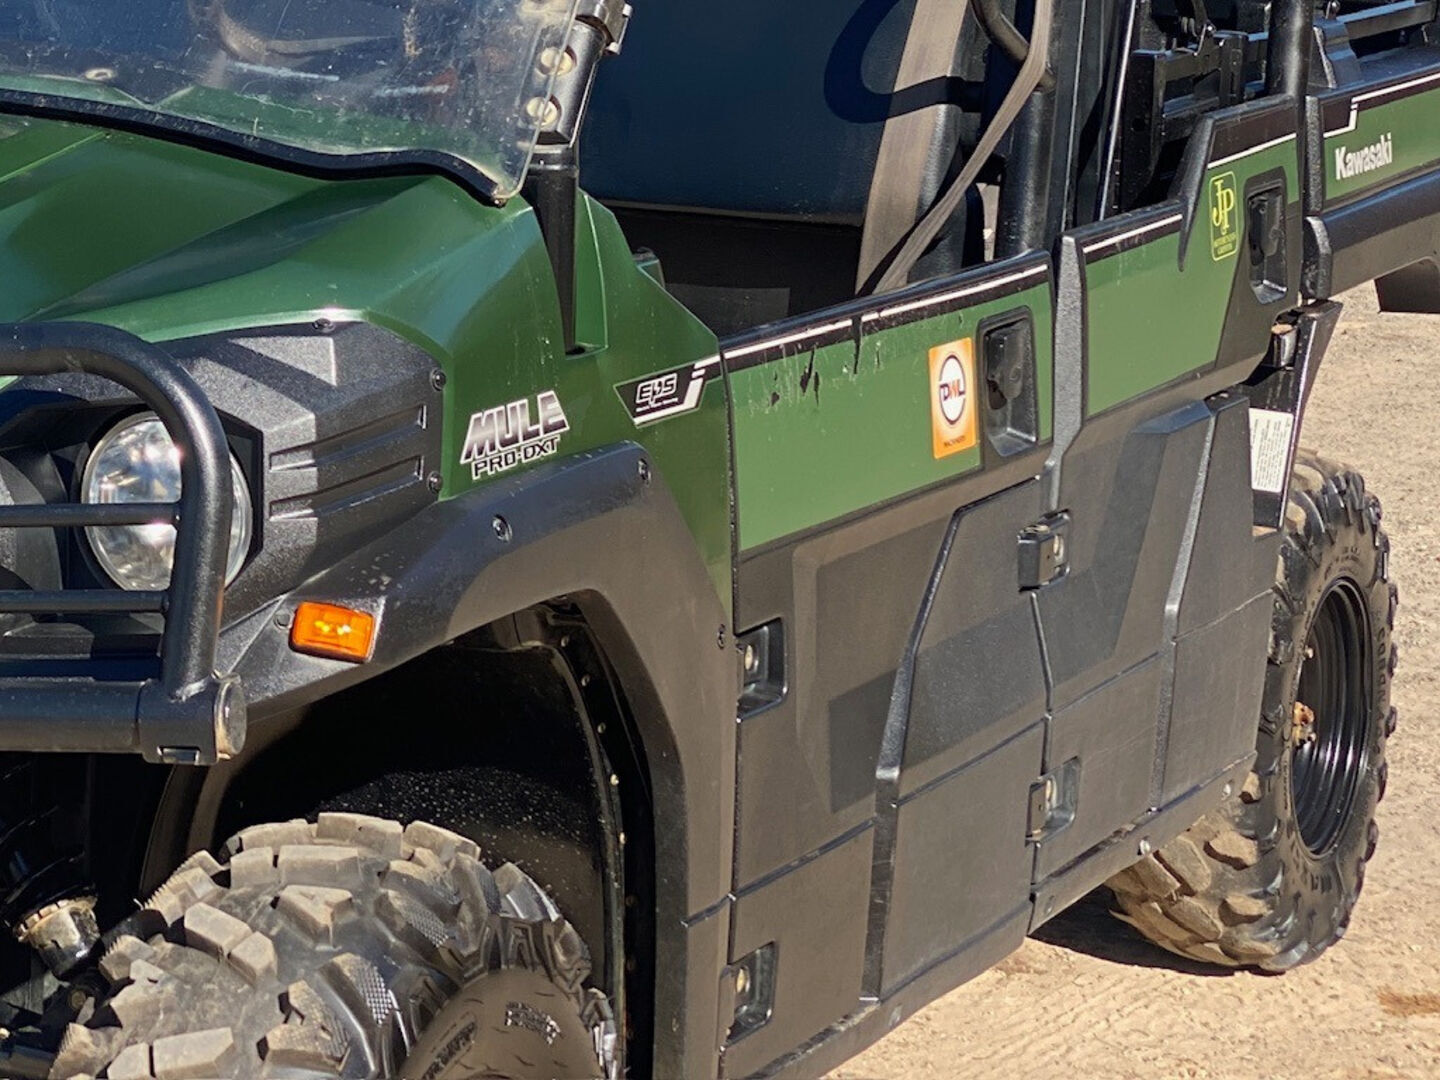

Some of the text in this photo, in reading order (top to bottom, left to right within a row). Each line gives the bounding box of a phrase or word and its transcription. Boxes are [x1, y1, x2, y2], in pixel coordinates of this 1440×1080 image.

[1335, 132, 1392, 180] Kawasaki
[636, 372, 678, 407] EPS
[460, 390, 570, 464] MULE
